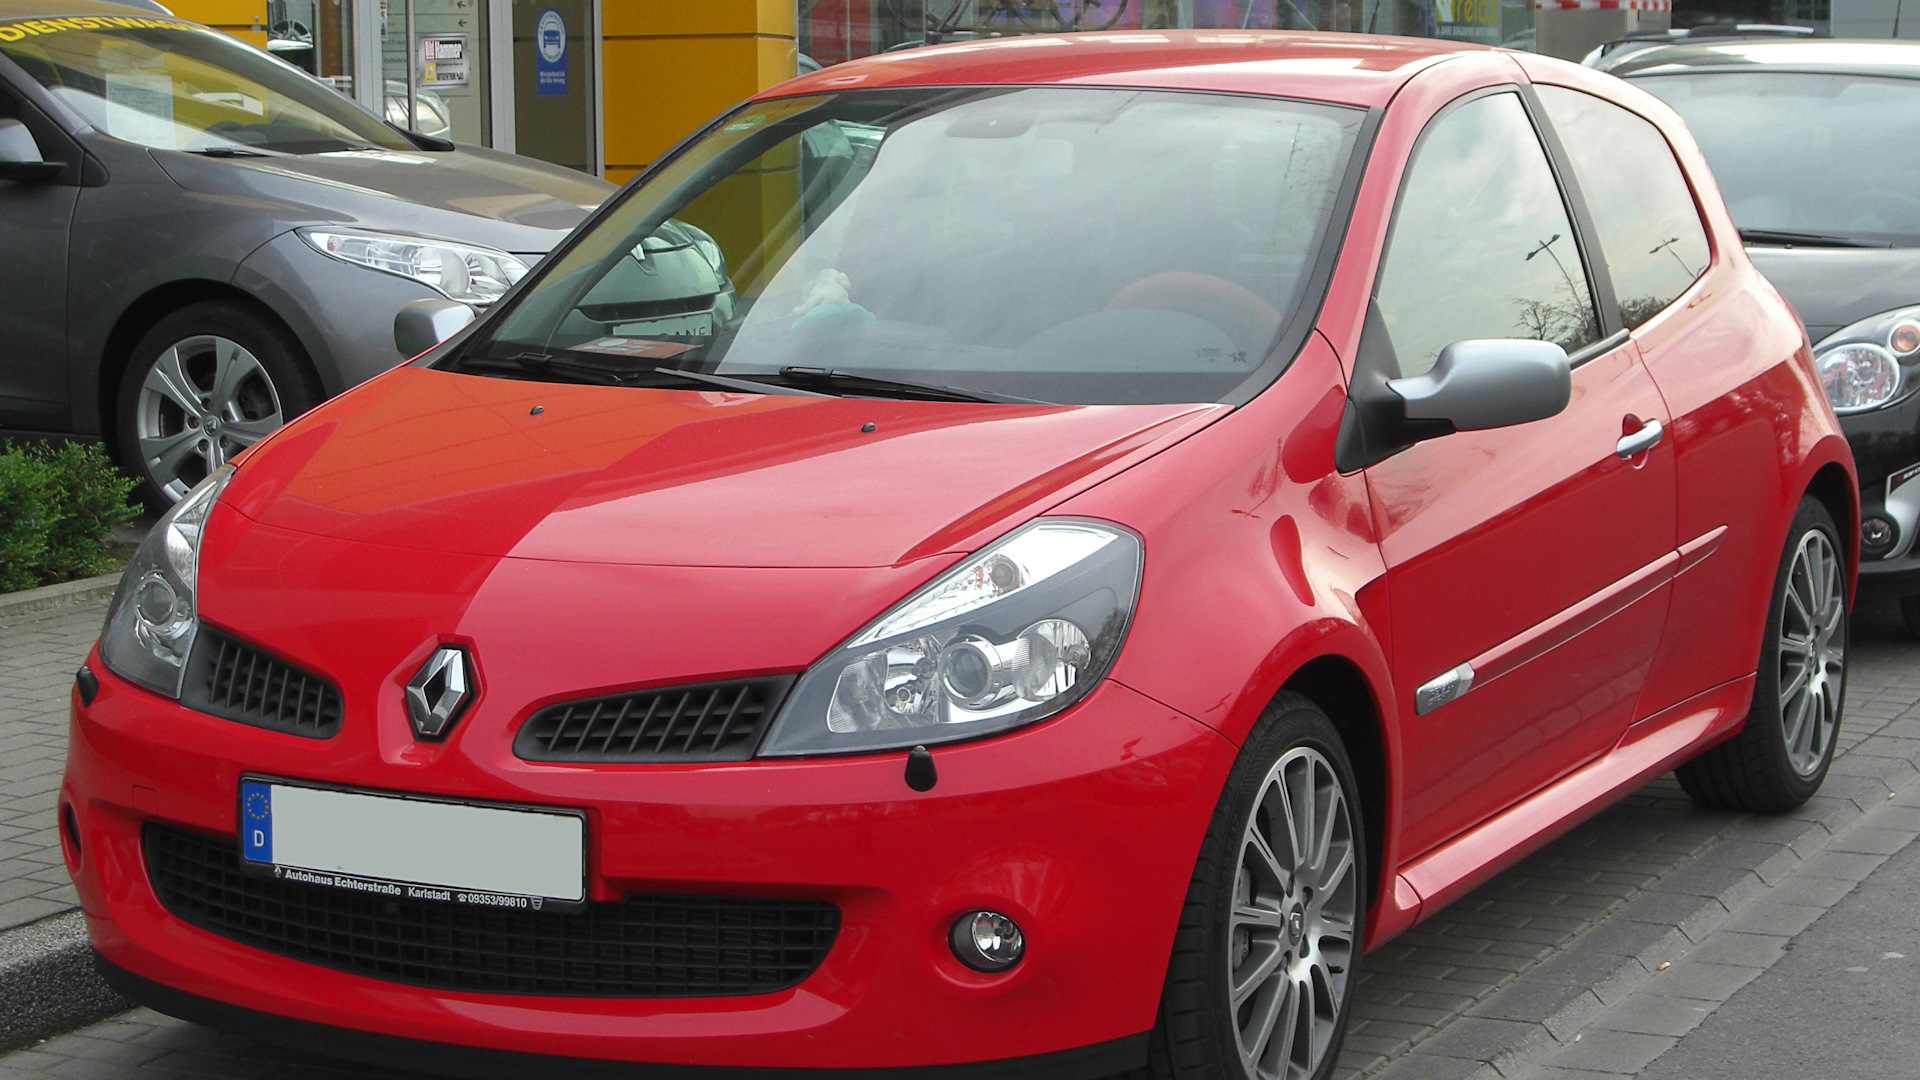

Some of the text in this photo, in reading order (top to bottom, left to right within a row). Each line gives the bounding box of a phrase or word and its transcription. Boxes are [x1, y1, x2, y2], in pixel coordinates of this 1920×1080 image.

[1457, 0, 1499, 23] relax
[254, 829, 264, 847] D
[285, 869, 527, 908] Autohaus Echterstraße Karlstadt 09353/99810
